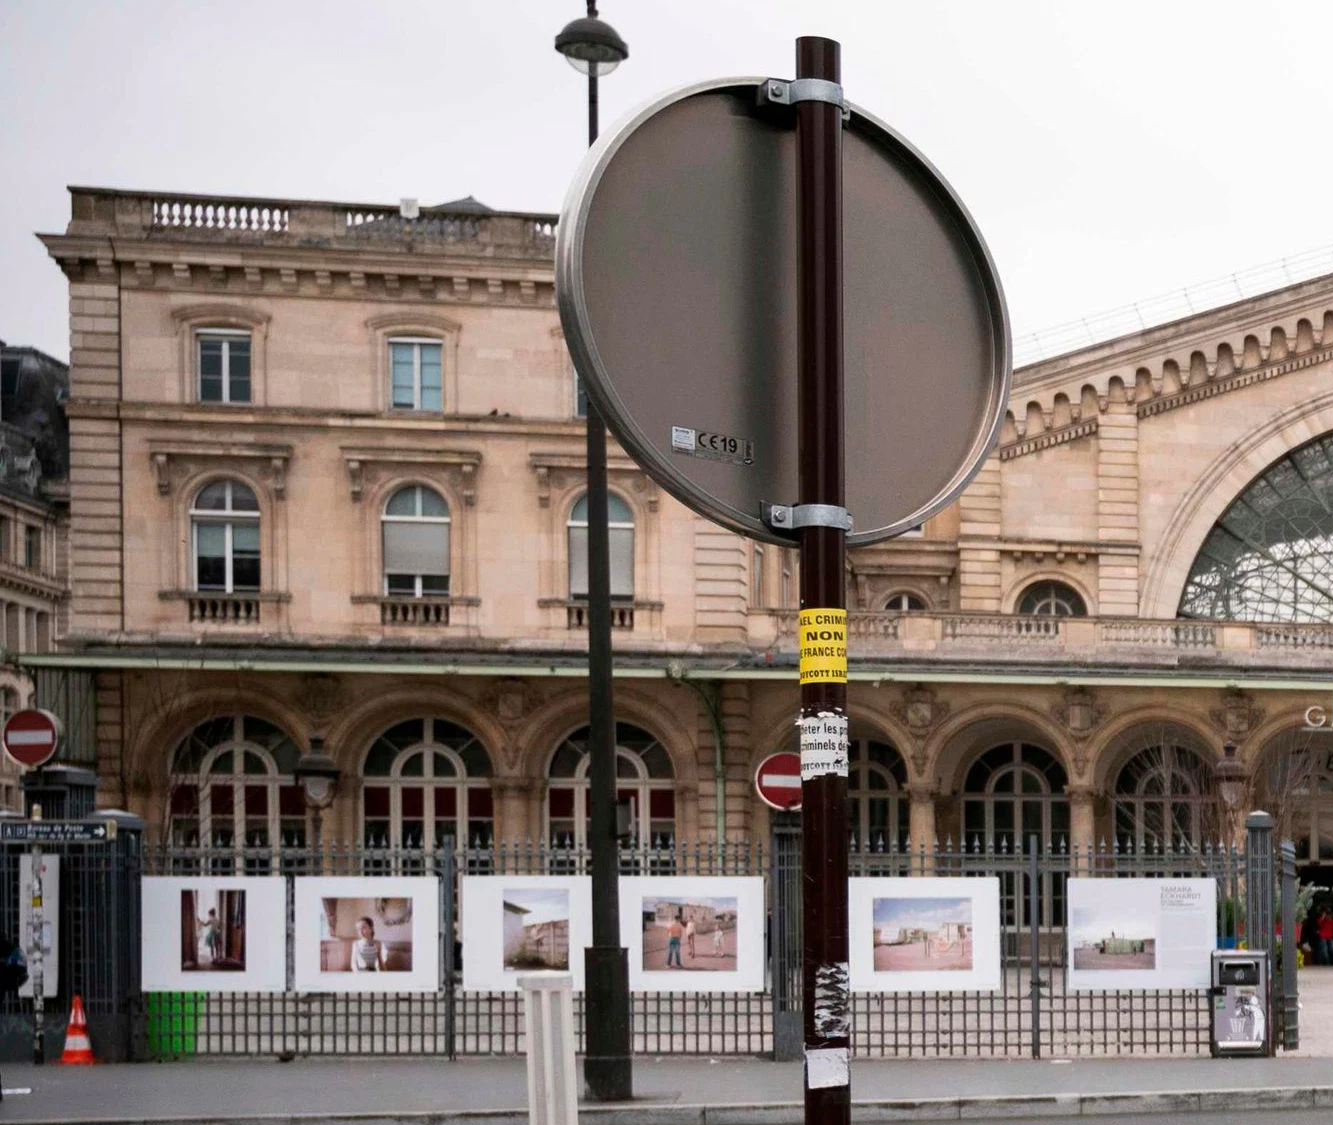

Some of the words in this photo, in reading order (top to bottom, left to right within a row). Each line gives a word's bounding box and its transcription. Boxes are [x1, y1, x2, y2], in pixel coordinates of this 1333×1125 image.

[806, 631, 844, 641] NON
[804, 647, 835, 657] FRANCE
[824, 723, 837, 734] les
